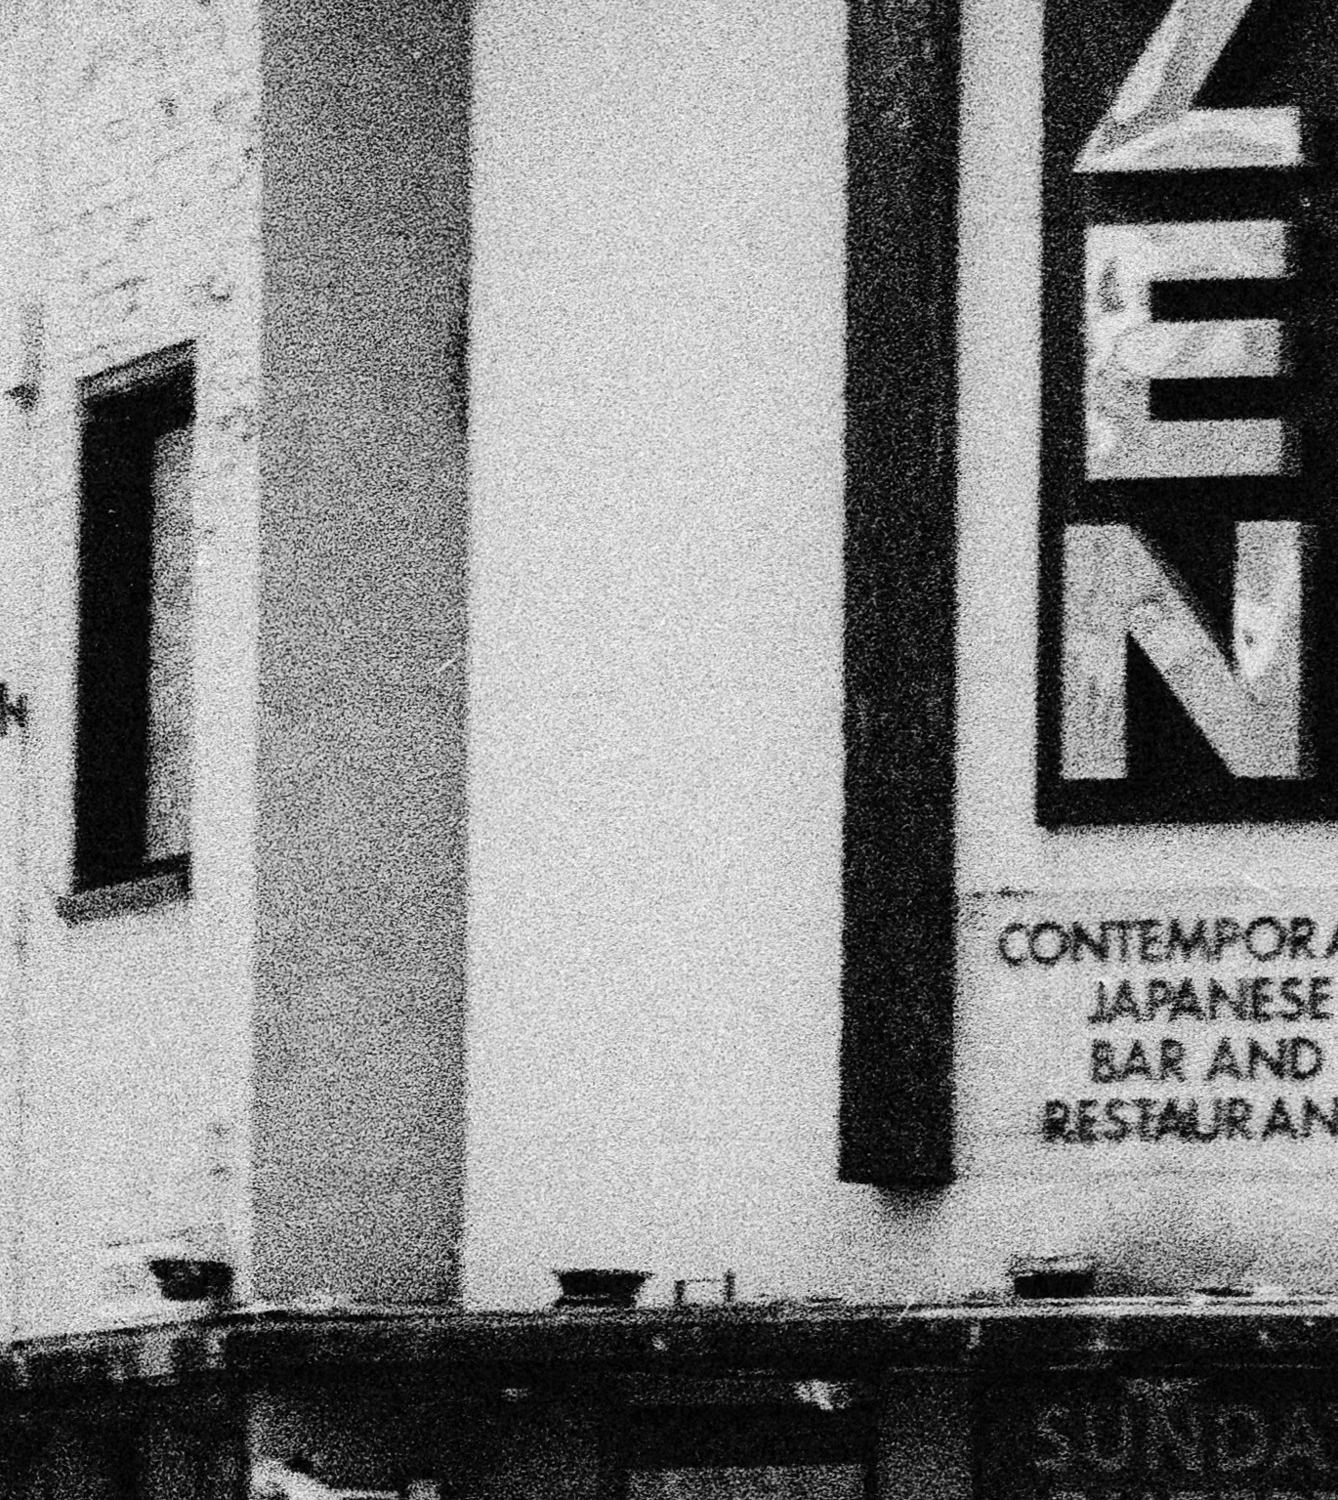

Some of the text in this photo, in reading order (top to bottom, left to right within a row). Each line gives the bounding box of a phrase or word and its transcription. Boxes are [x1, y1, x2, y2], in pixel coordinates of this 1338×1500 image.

[1088, 976, 1333, 1024] JAPANESE
[1090, 1036, 1324, 1084] BAR AND
